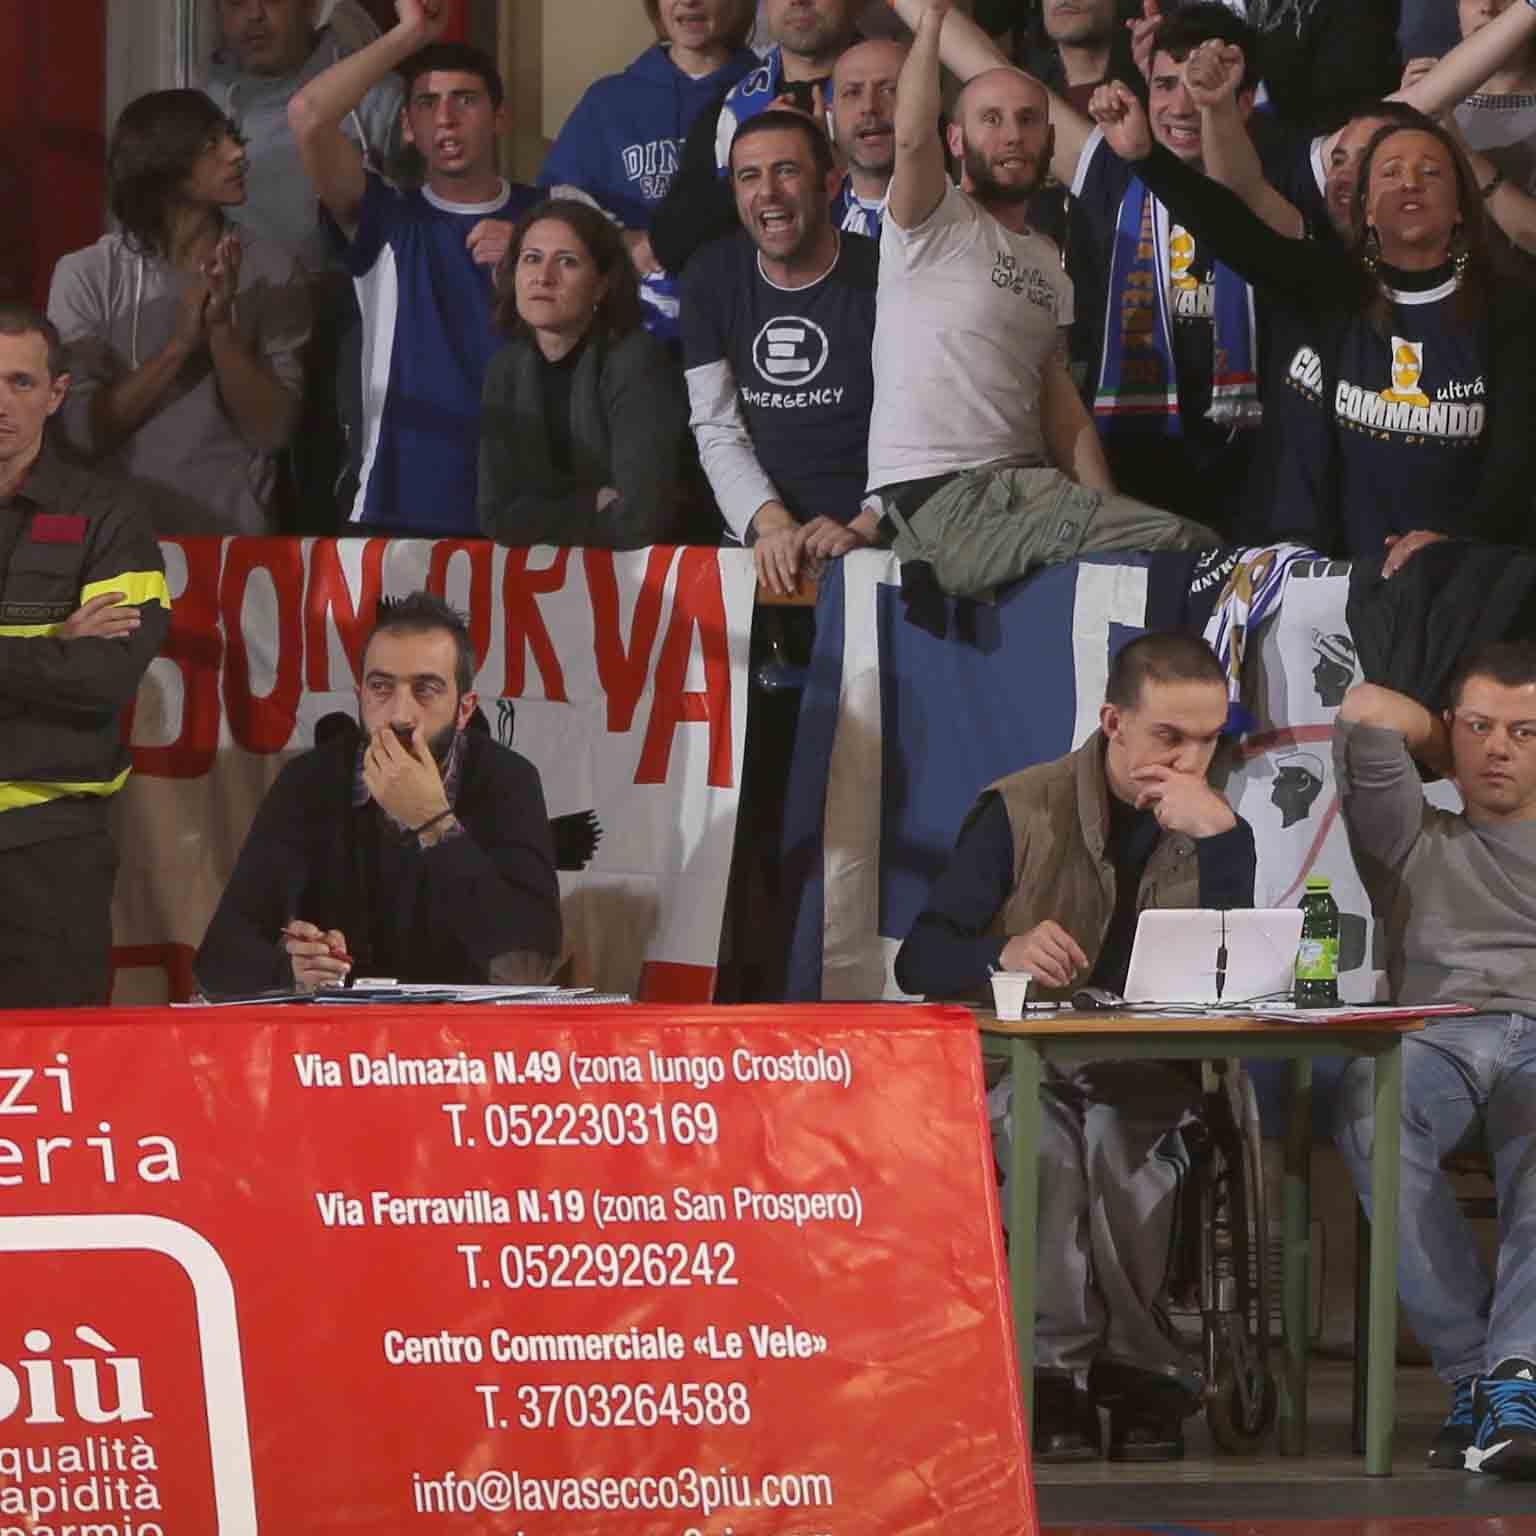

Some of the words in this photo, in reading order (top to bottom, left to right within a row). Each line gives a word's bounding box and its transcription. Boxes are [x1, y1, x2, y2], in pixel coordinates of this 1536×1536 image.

[741, 386, 844, 409] EMERGENCY
[1335, 379, 1485, 439] COMMANDO
[295, 1055, 341, 1086] Via
[350, 1052, 487, 1085] Dalmazia
[494, 1051, 561, 1083] N.49
[570, 1052, 643, 1089] (zona
[650, 1051, 724, 1088] lungo
[733, 1049, 851, 1088] Crostolo)
[443, 1104, 474, 1146] T.
[486, 1103, 717, 1146] 0522303169
[317, 1193, 364, 1225] Via
[372, 1191, 510, 1224] Ferravilla
[518, 1190, 584, 1221] N.19
[594, 1190, 666, 1228] (zona
[674, 1188, 725, 1220] San
[734, 1187, 862, 1226] Prospero)
[458, 1246, 489, 1288] T.
[501, 1243, 738, 1288] 0522926242
[385, 1331, 482, 1363] Centro
[491, 1327, 684, 1361] Commerciale
[476, 1386, 506, 1427] T.
[519, 1383, 750, 1427] 3703264588
[0, 1436, 157, 1483] qualità
[415, 1468, 832, 1515] info@lavasecco3piu.com
